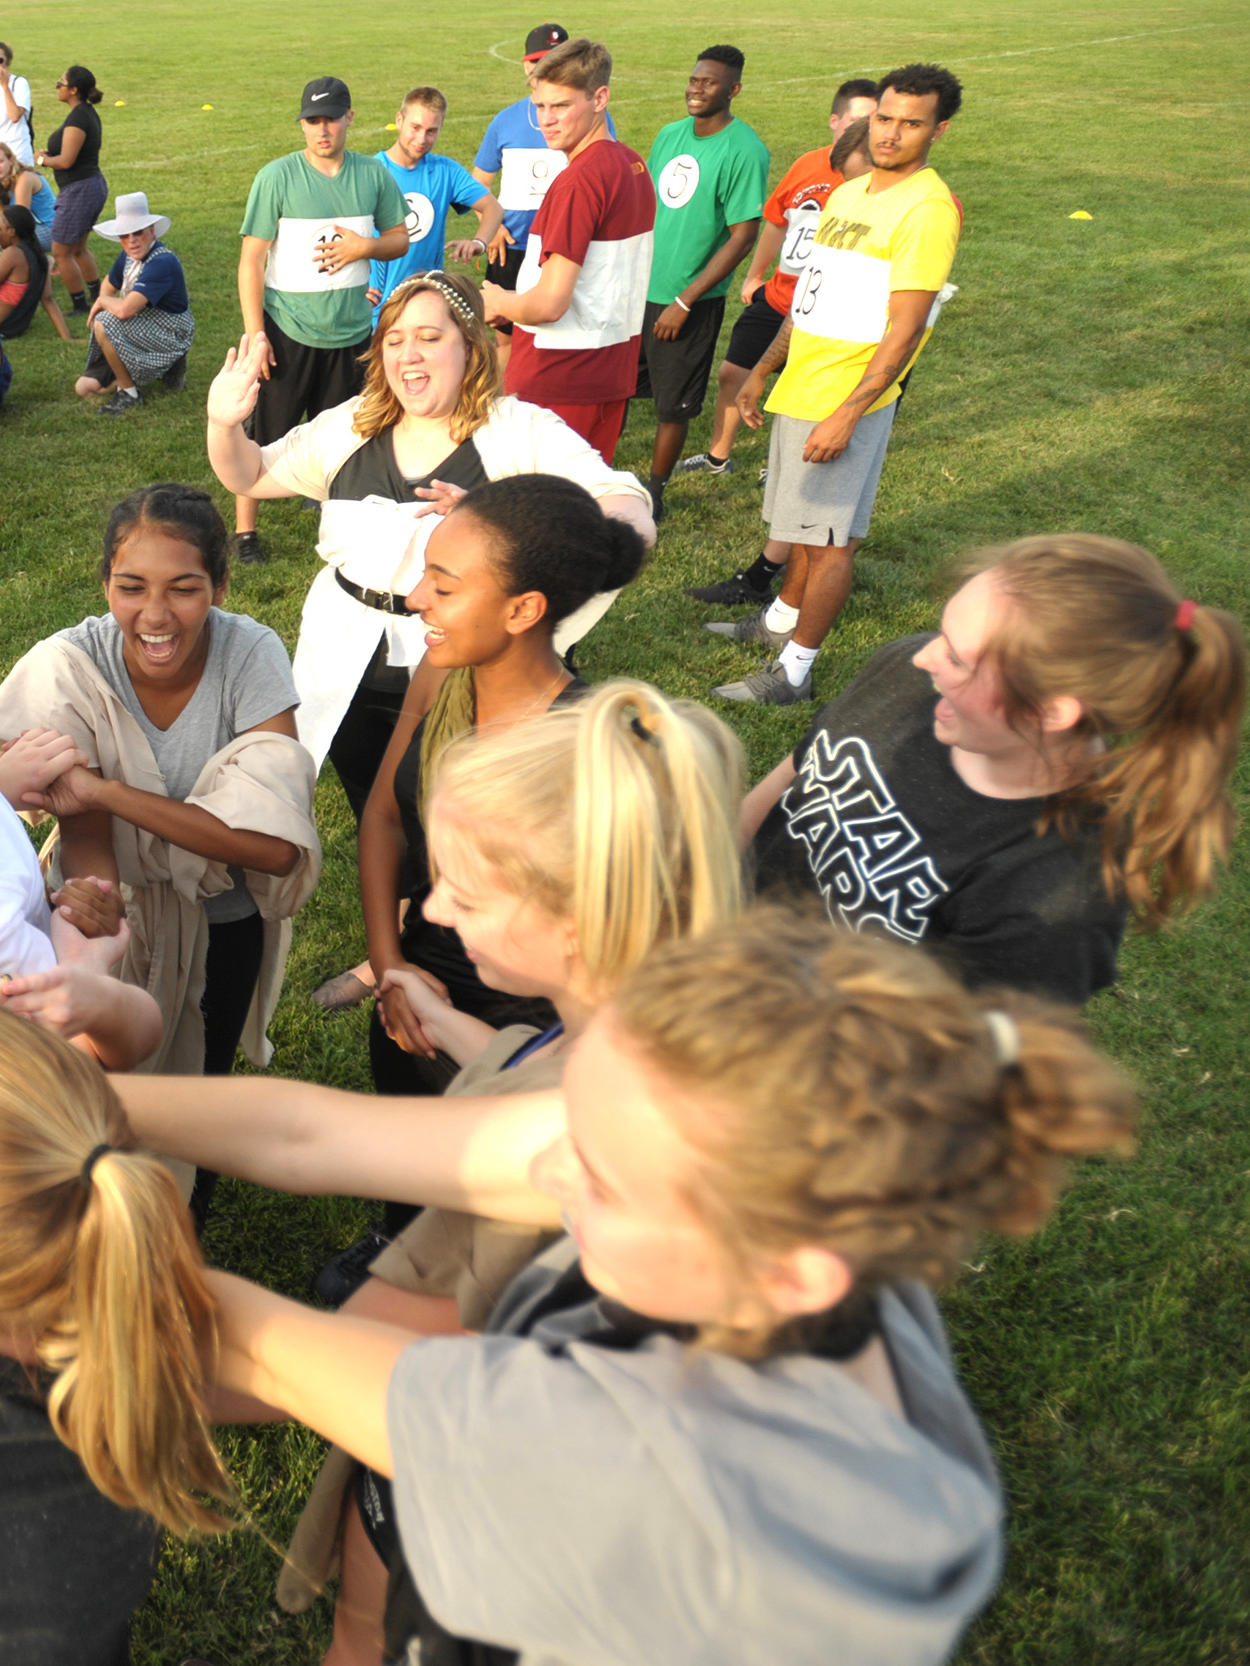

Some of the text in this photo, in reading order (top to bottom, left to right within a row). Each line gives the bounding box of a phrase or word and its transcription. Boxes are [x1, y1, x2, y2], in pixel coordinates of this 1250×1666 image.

[531, 160, 549, 191] 9
[667, 162, 692, 199] 5
[786, 226, 817, 260] 15
[795, 266, 823, 315] 13
